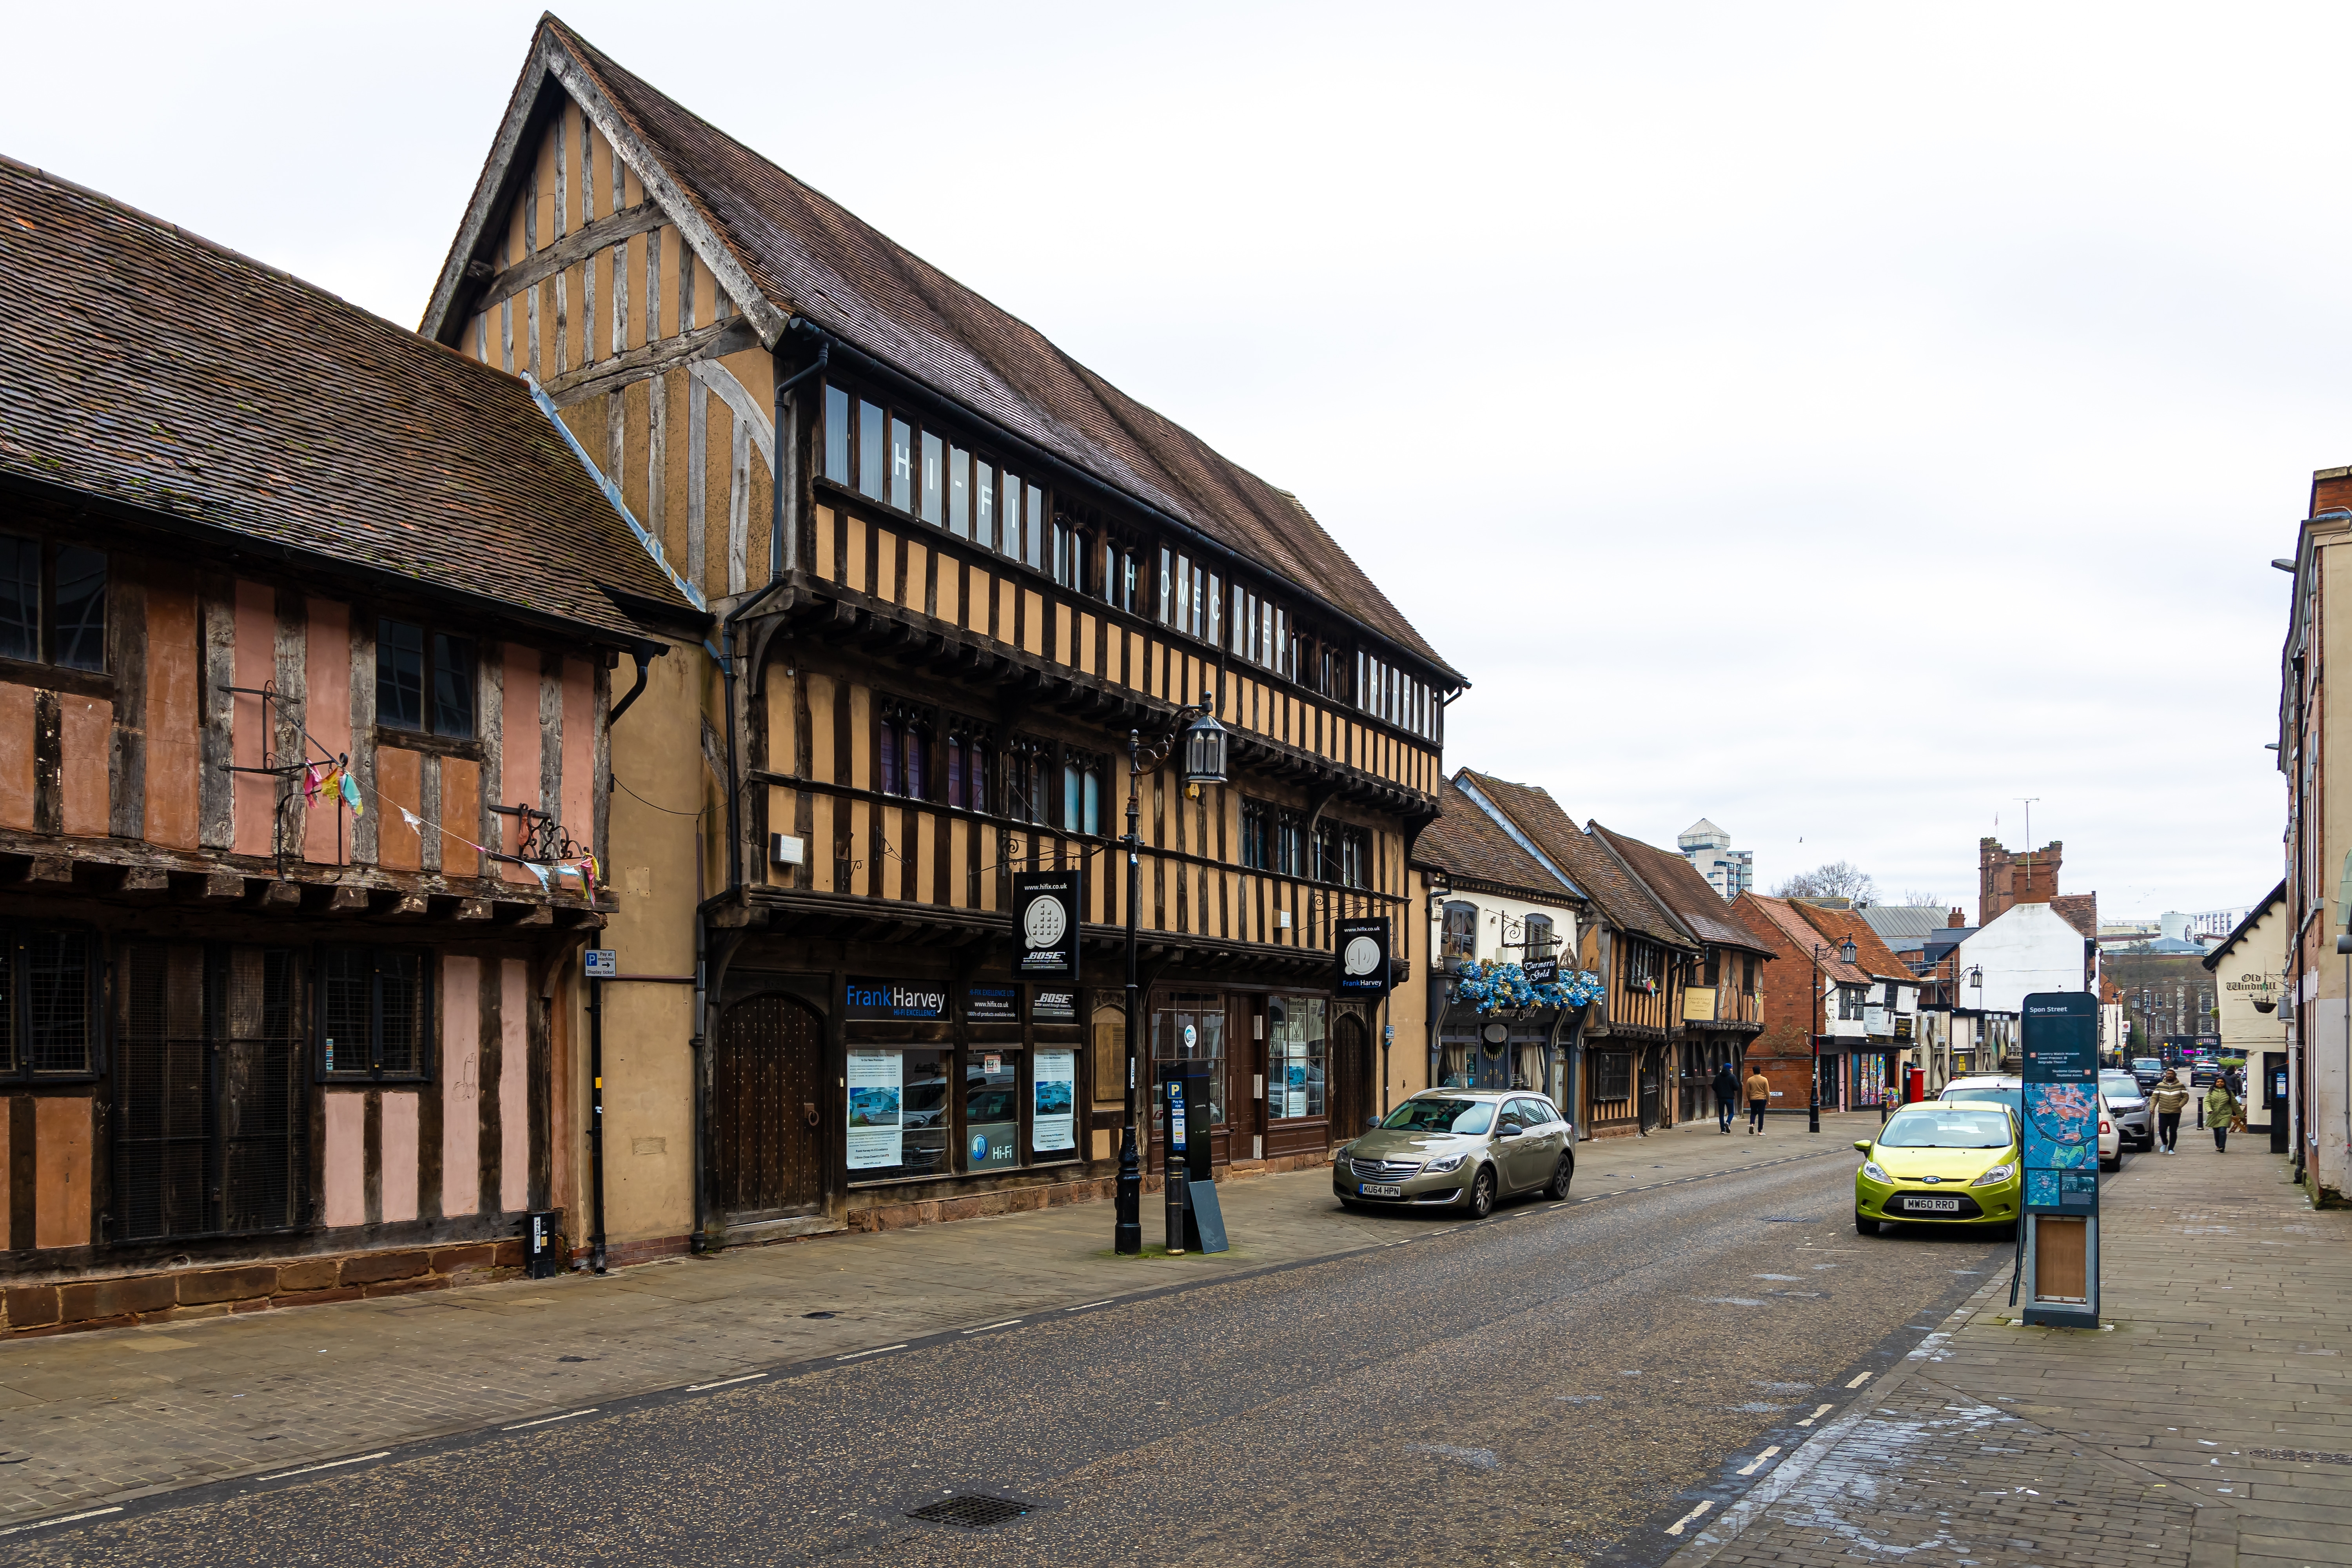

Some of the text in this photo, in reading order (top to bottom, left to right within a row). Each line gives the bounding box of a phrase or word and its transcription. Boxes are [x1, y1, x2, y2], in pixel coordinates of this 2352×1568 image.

[895, 443, 1015, 528] HI-FI
[589, 955, 595, 964] P
[1524, 960, 1555, 970] Turmeric
[1530, 969, 1550, 981] Gold
[2241, 974, 2261, 982] Old
[1034, 993, 1073, 1003] BOSE
[1171, 1084, 1180, 1095] P
[993, 1145, 1012, 1160] Hi-Fi
[1364, 1185, 1399, 1195] KU64 HPN
[1908, 1200, 1955, 1209] MW60 RRO
